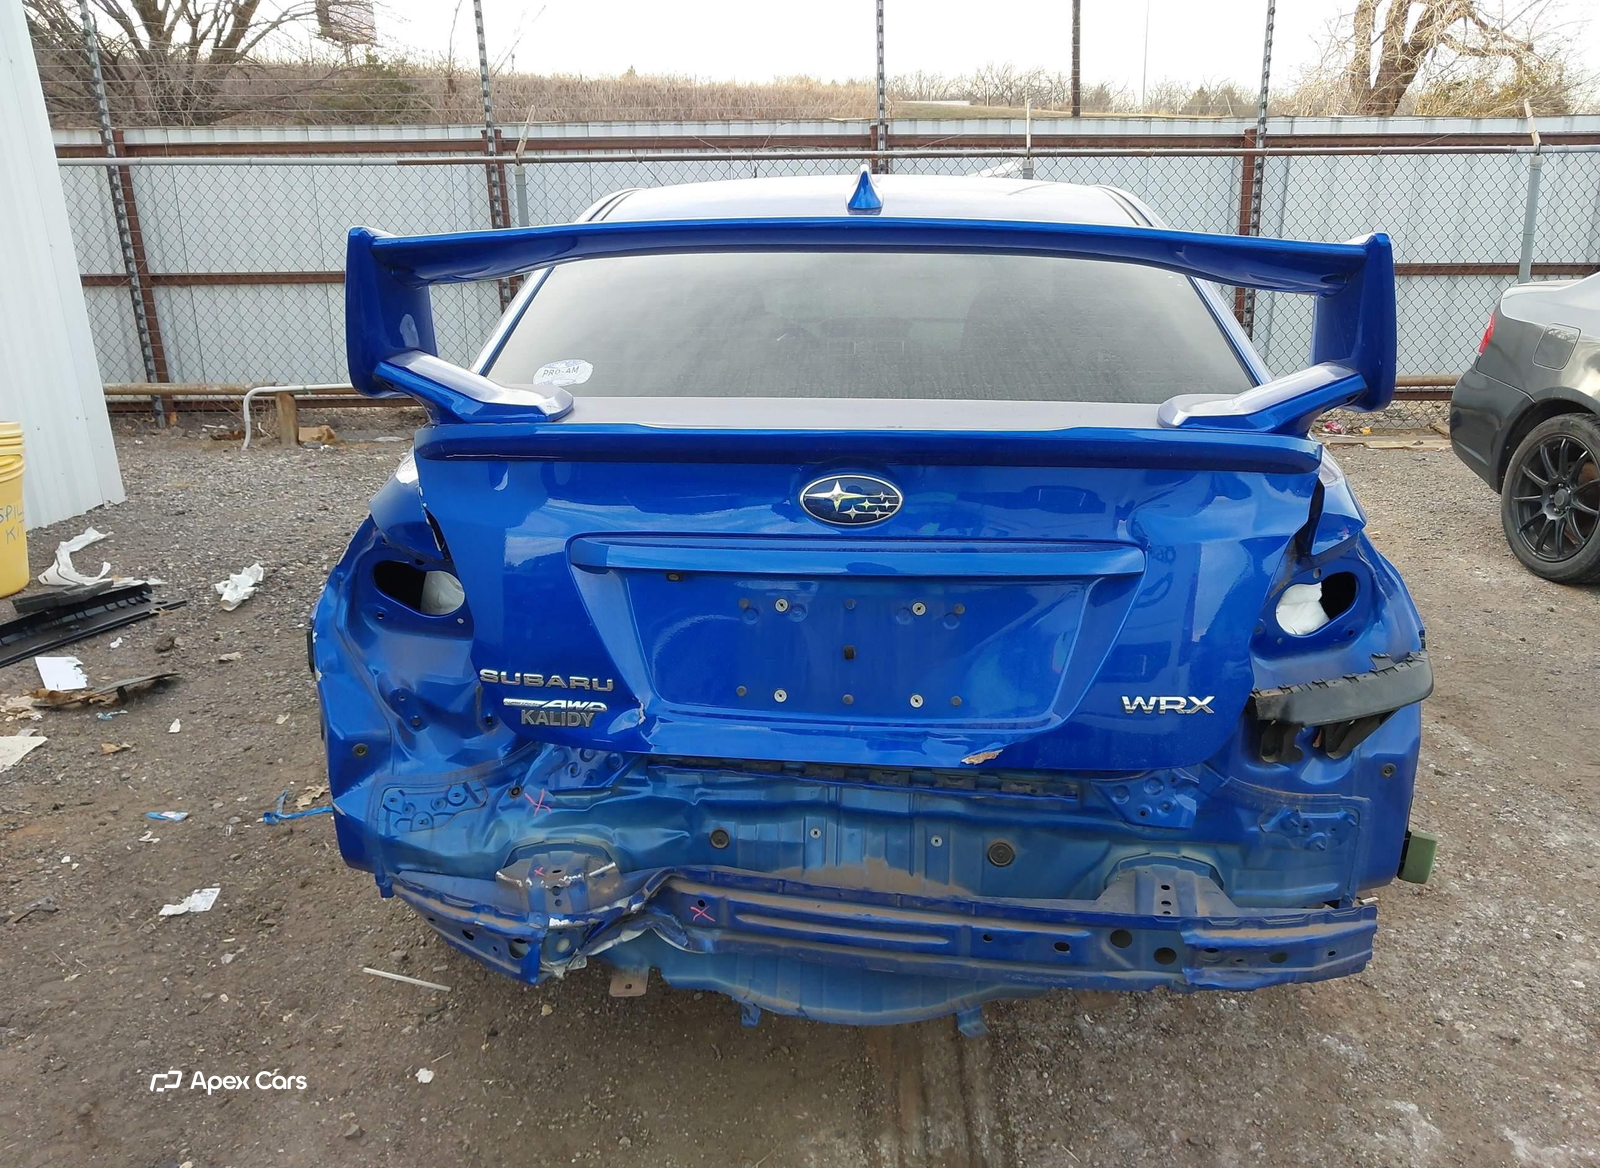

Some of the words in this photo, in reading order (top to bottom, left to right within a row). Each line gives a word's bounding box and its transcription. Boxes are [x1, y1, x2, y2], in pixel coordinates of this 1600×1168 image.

[542, 365, 580, 378] PRO-AM
[479, 668, 614, 692] SUBARU
[541, 699, 608, 712] AWD
[1121, 695, 1215, 714] WRX
[521, 709, 595, 728] KALIDY
